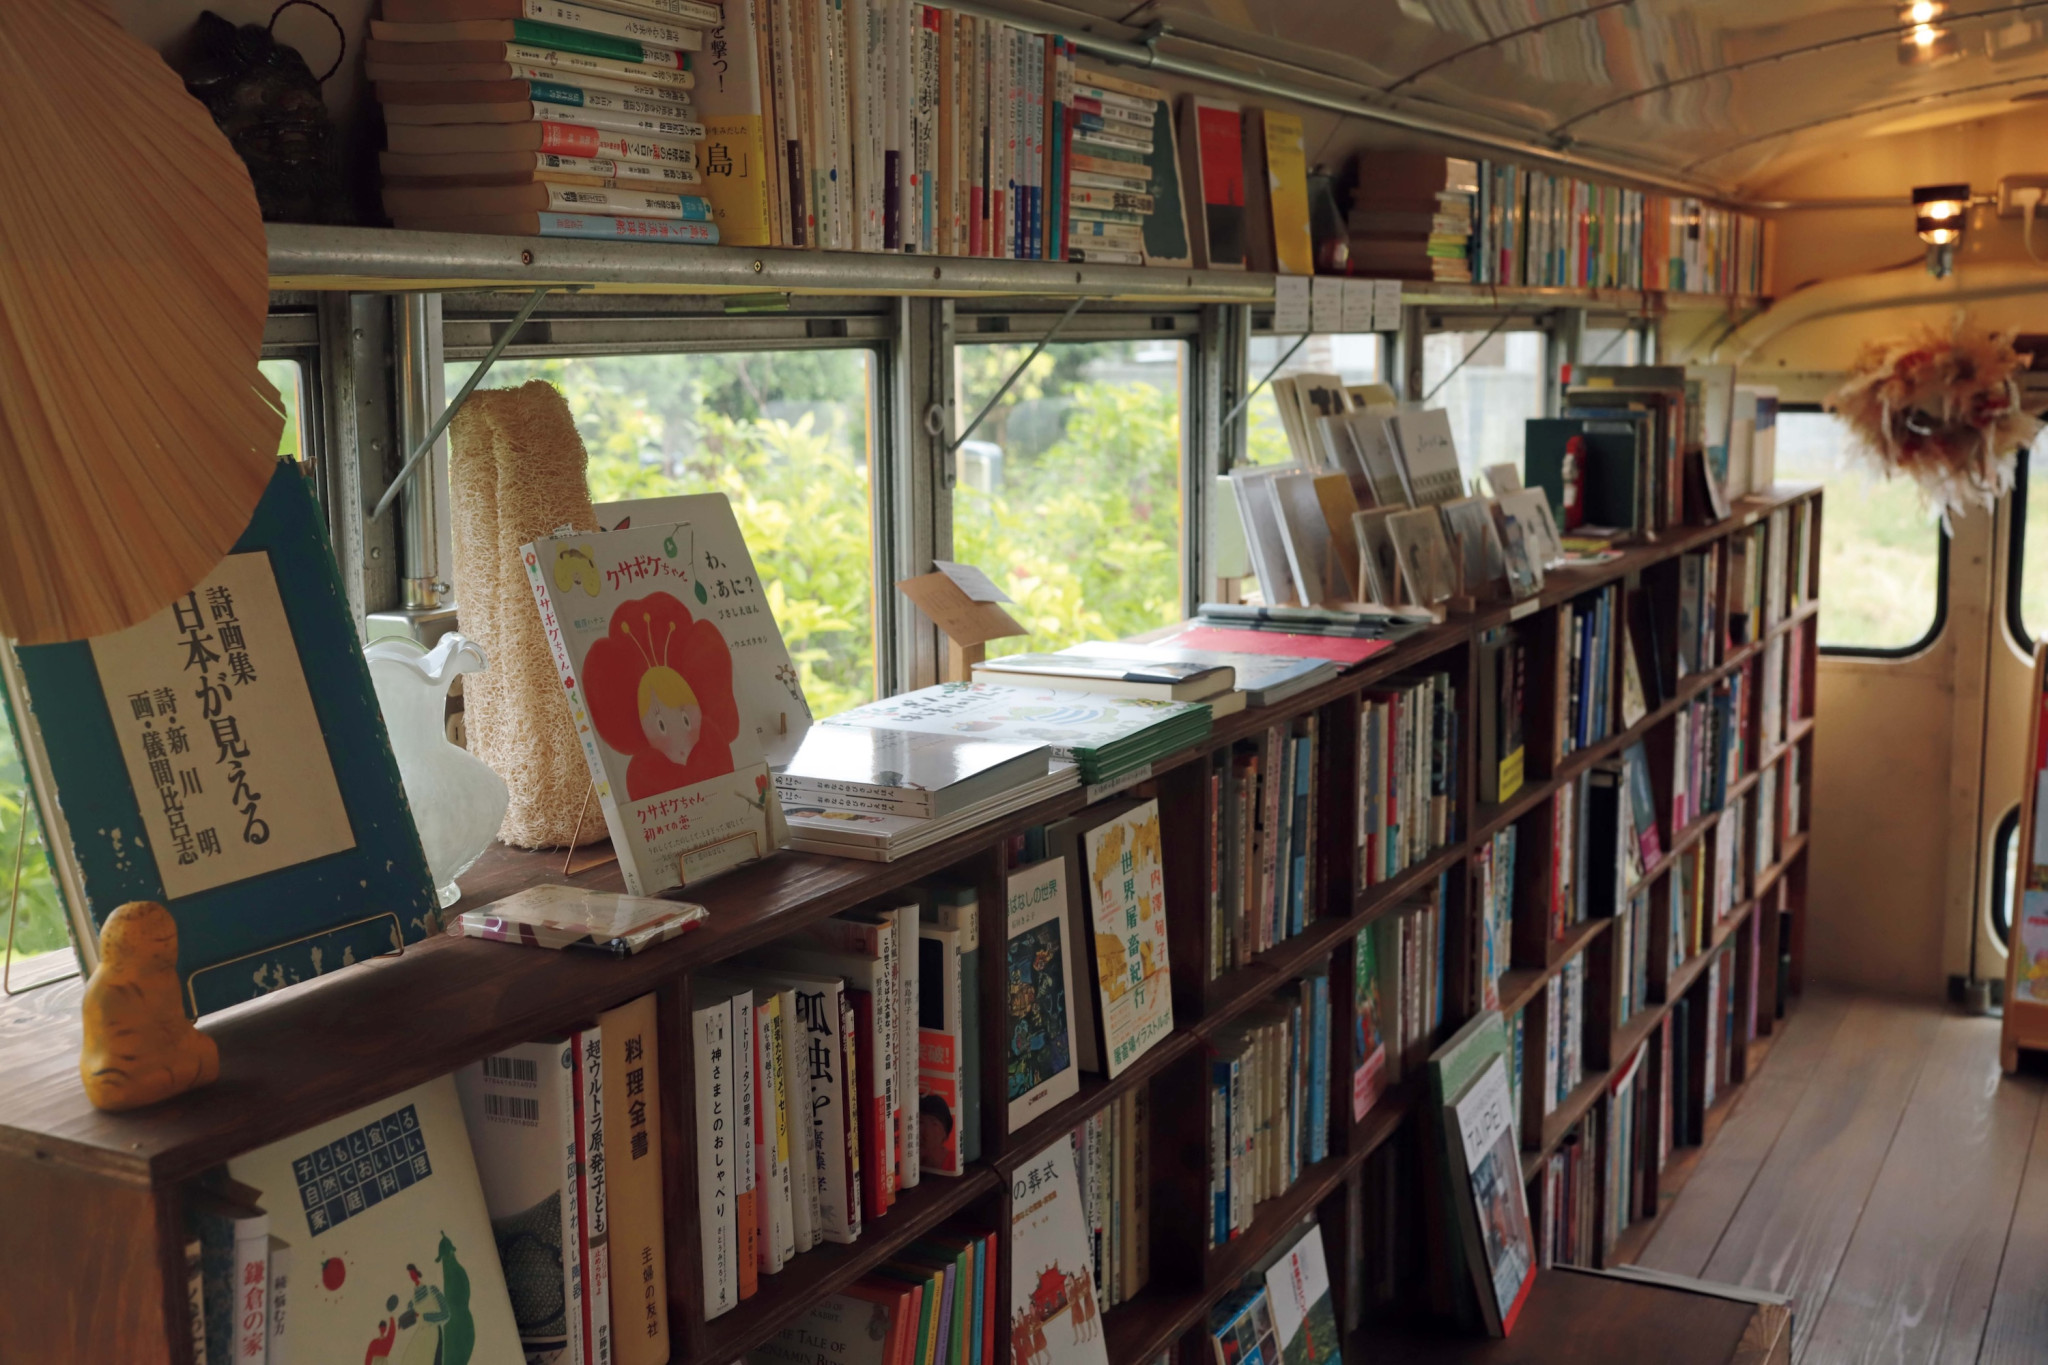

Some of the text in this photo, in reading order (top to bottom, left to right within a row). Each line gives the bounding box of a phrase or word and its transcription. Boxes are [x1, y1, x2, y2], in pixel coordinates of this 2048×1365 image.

[625, 22, 681, 42] 沖縄の心を求めて
[651, 69, 687, 85] 民族の怒り
[627, 140, 691, 164] 琉球歴史の謎とロマン
[606, 554, 688, 591] クサボケちゃん
[205, 585, 257, 687] 詩画集
[535, 584, 570, 672] クサボケちゃん
[172, 590, 271, 846] 日本が見える
[817, 781, 896, 798] おきなわゆびさしえほん
[817, 795, 896, 812] おきなわゆびさしえほん
[1121, 850, 1146, 1010] 世界屠畜紀行
[1150, 868, 1167, 962] 内澤旬子
[624, 1034, 649, 1161] 料理全書
[741, 1005, 751, 1128] オードリー・タンの思考
[763, 1021, 773, 1089] 夜を乗り越える
[773, 1015, 788, 1137] 賢者たちのメッセージ
[297, 1108, 417, 1181] 子どもと食べる
[585, 1039, 606, 1234] 超ウルトラ原発子ども
[711, 1048, 726, 1217] 神さまとのおしゃべり
[310, 1157, 431, 1230] 家庭料理
[1013, 1160, 1059, 1200] の葬式
[242, 1260, 265, 1356] 鎌倉の家
[640, 1246, 660, 1340] 主婦の友社
[799, 1329, 827, 1349] TALE
[830, 1342, 847, 1354] OF
